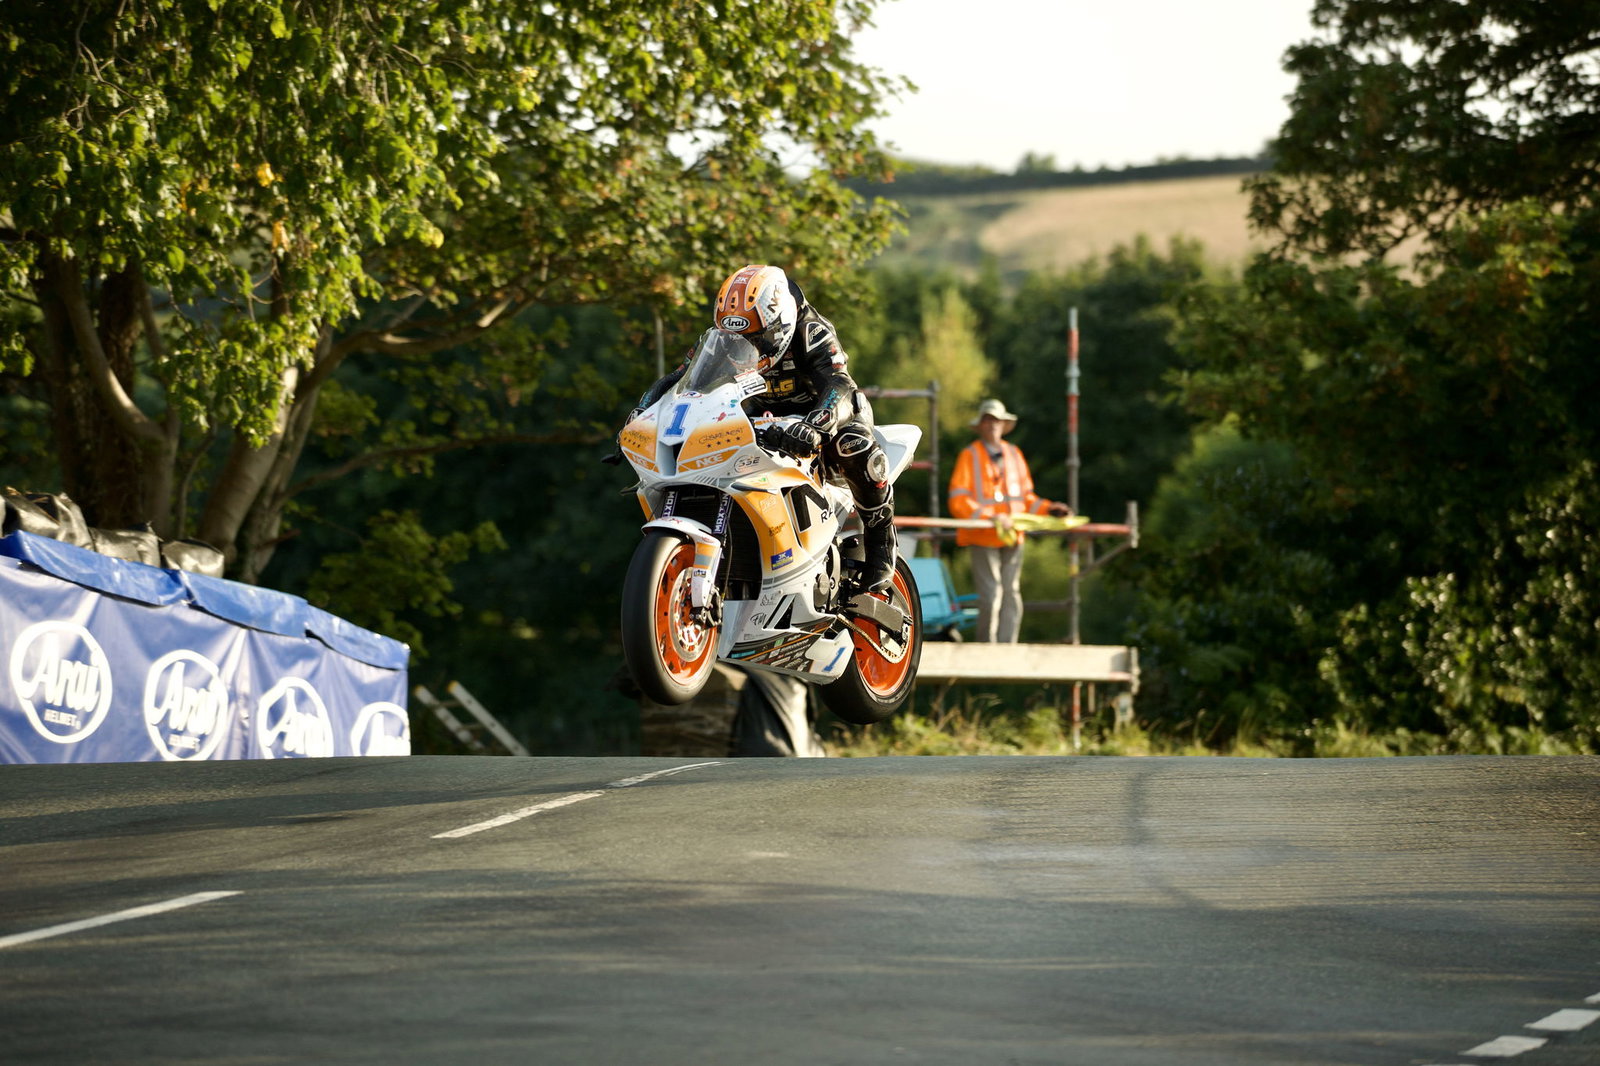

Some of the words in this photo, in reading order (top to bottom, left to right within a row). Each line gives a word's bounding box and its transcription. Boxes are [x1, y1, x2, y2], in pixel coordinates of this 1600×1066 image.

[723, 318, 746, 328] Arai
[664, 403, 691, 437] 1
[20, 632, 101, 713] Arai
[822, 647, 846, 672] 1
[148, 661, 220, 735] Arai
